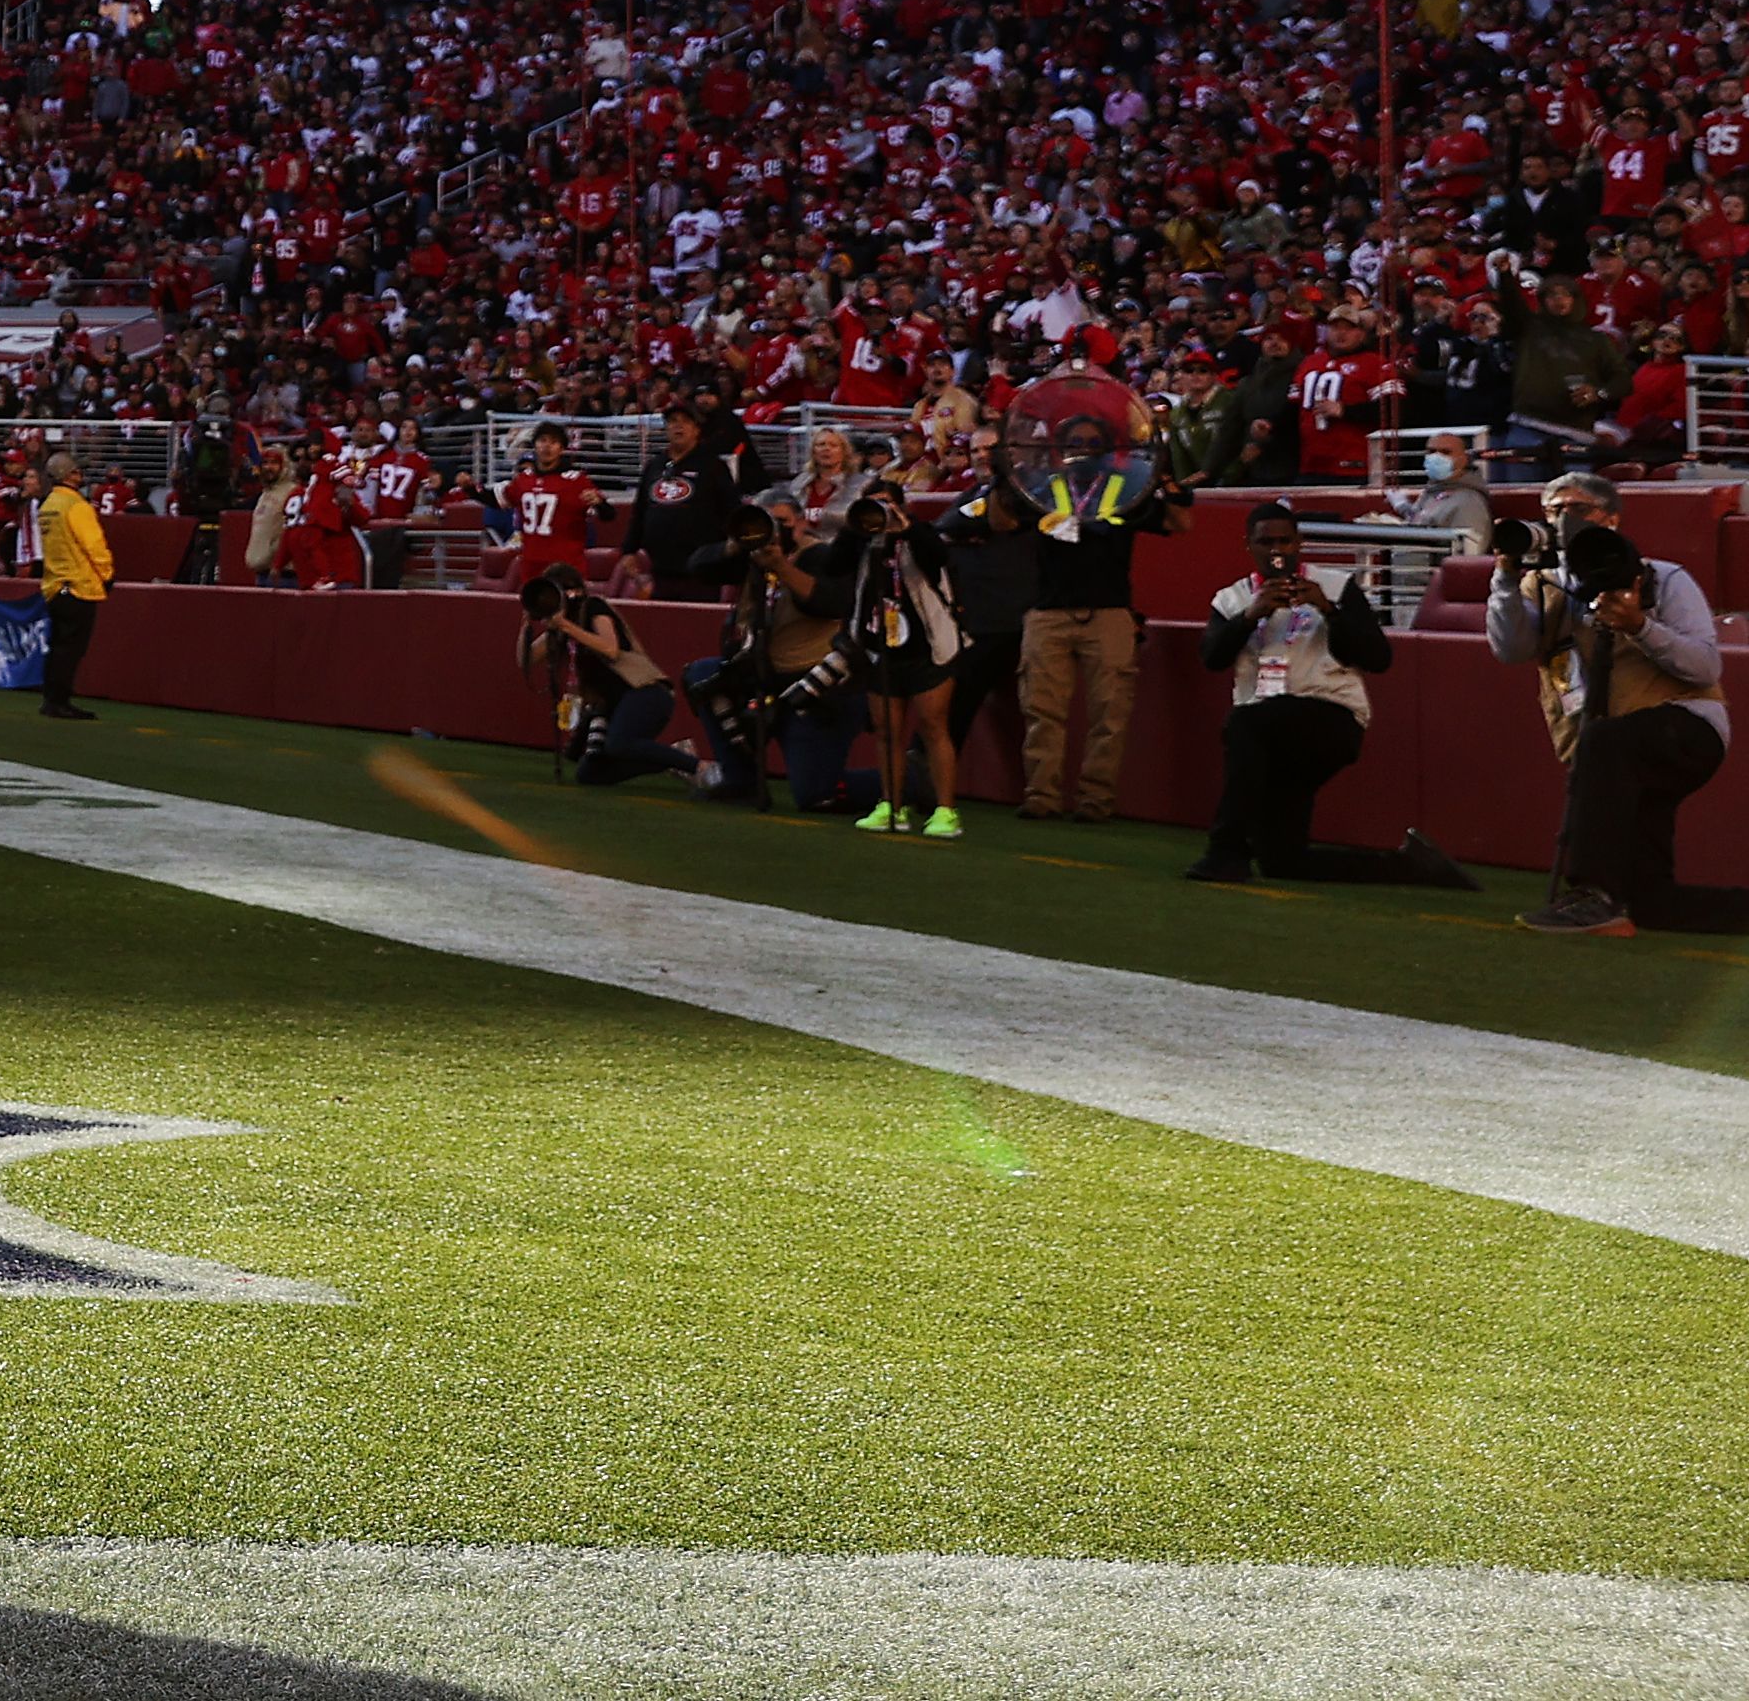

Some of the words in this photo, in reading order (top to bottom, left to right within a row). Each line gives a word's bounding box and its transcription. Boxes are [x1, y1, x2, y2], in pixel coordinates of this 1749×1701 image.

[1545, 101, 1566, 126] 5
[1706, 124, 1743, 155] 85
[1608, 150, 1645, 181] 44
[314, 218, 329, 238] 11
[851, 337, 883, 373] 16
[1303, 370, 1344, 410] 10
[380, 463, 416, 500] 97
[100, 492, 116, 516] 5
[521, 492, 558, 536] 97
